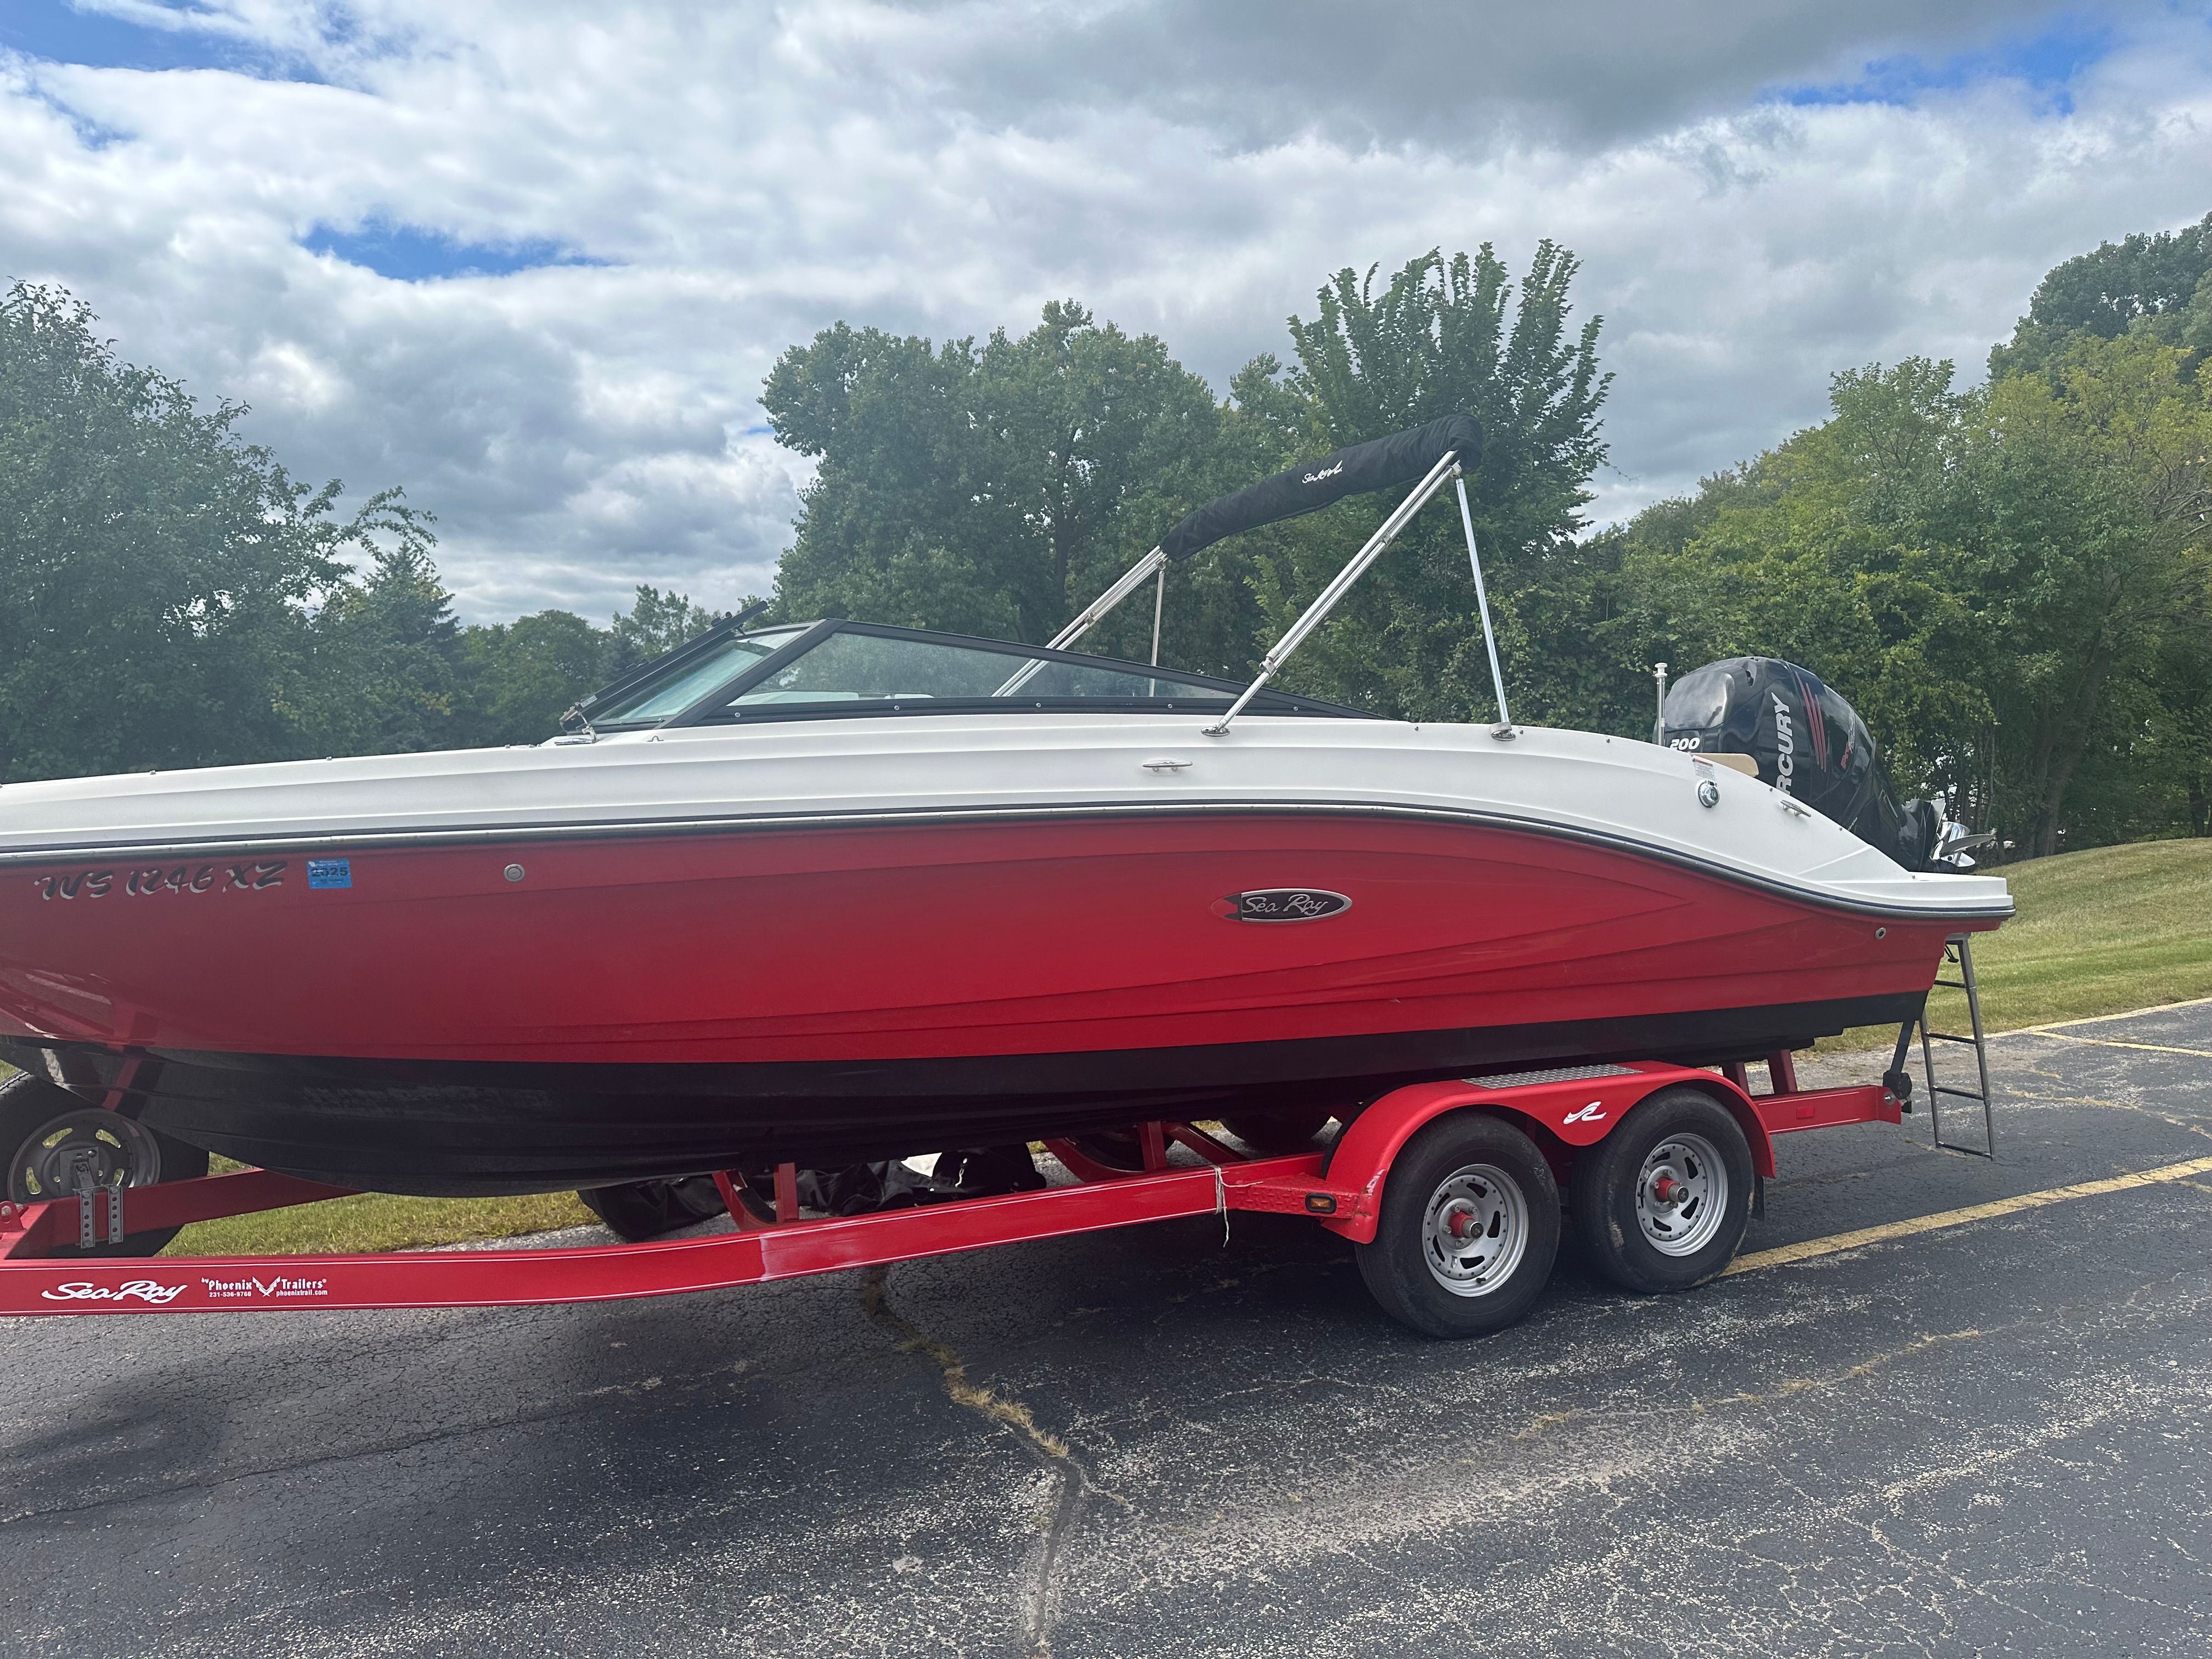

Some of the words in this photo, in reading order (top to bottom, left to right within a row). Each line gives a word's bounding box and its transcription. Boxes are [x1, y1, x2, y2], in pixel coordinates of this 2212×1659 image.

[1669, 737, 1700, 751] 200
[311, 867, 348, 877] 2025
[34, 870, 114, 901] WS
[126, 864, 215, 897] 1246
[222, 860, 288, 893] XZ
[1242, 896, 1281, 913] Sea
[1283, 894, 1329, 916] Ray
[41, 1282, 117, 1300] Sea
[113, 1279, 188, 1304] Ray
[208, 1279, 252, 1291] Phoenix
[276, 1289, 328, 1297] phoenixtrail.com
